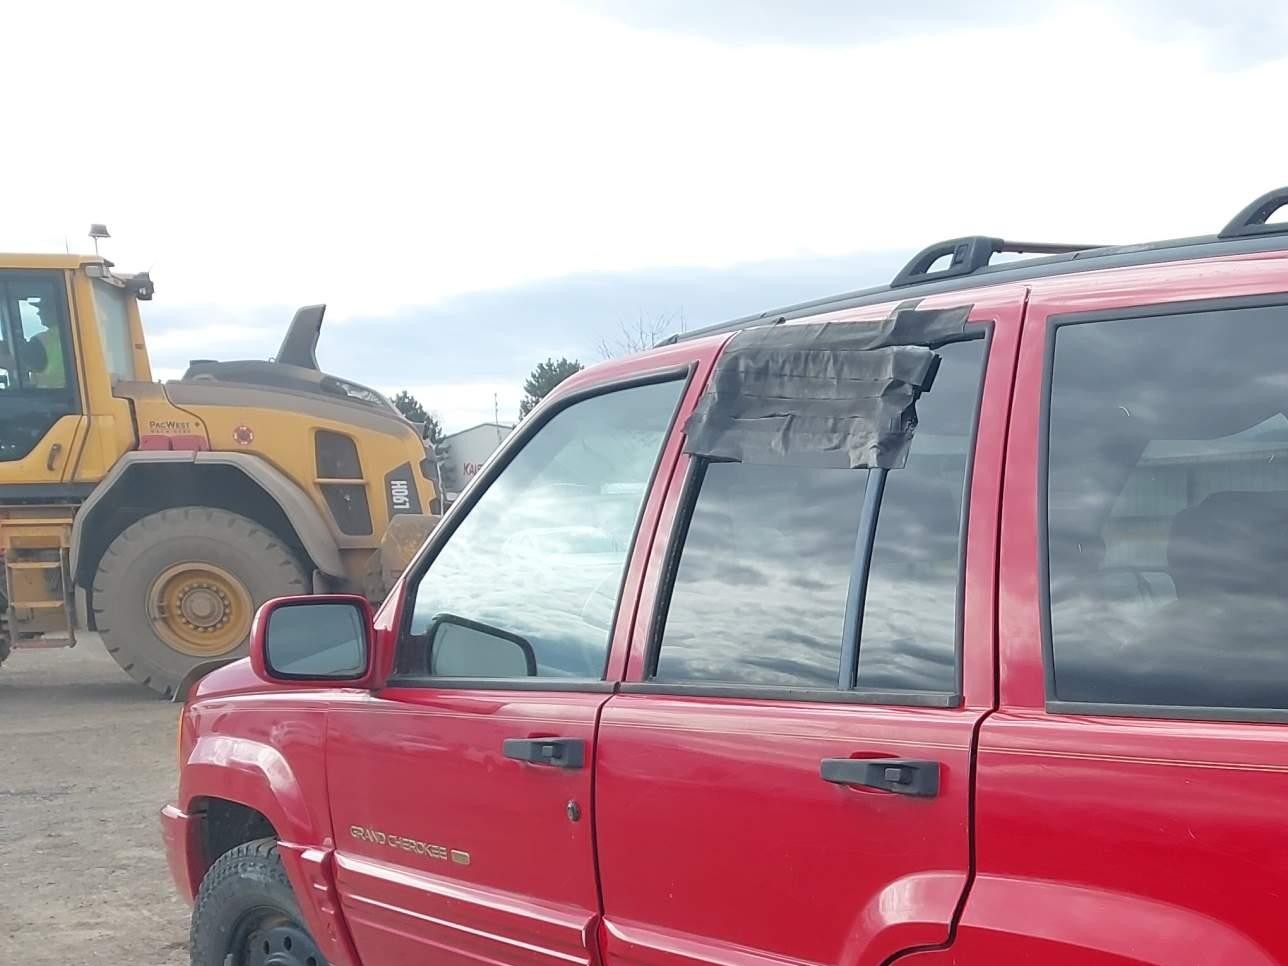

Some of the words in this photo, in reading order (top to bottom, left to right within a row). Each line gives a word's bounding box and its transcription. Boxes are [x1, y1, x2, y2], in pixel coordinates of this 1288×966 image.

[391, 480, 410, 509] L90H
[350, 825, 386, 845] GRAND
[387, 834, 448, 861] CHEROKEE
